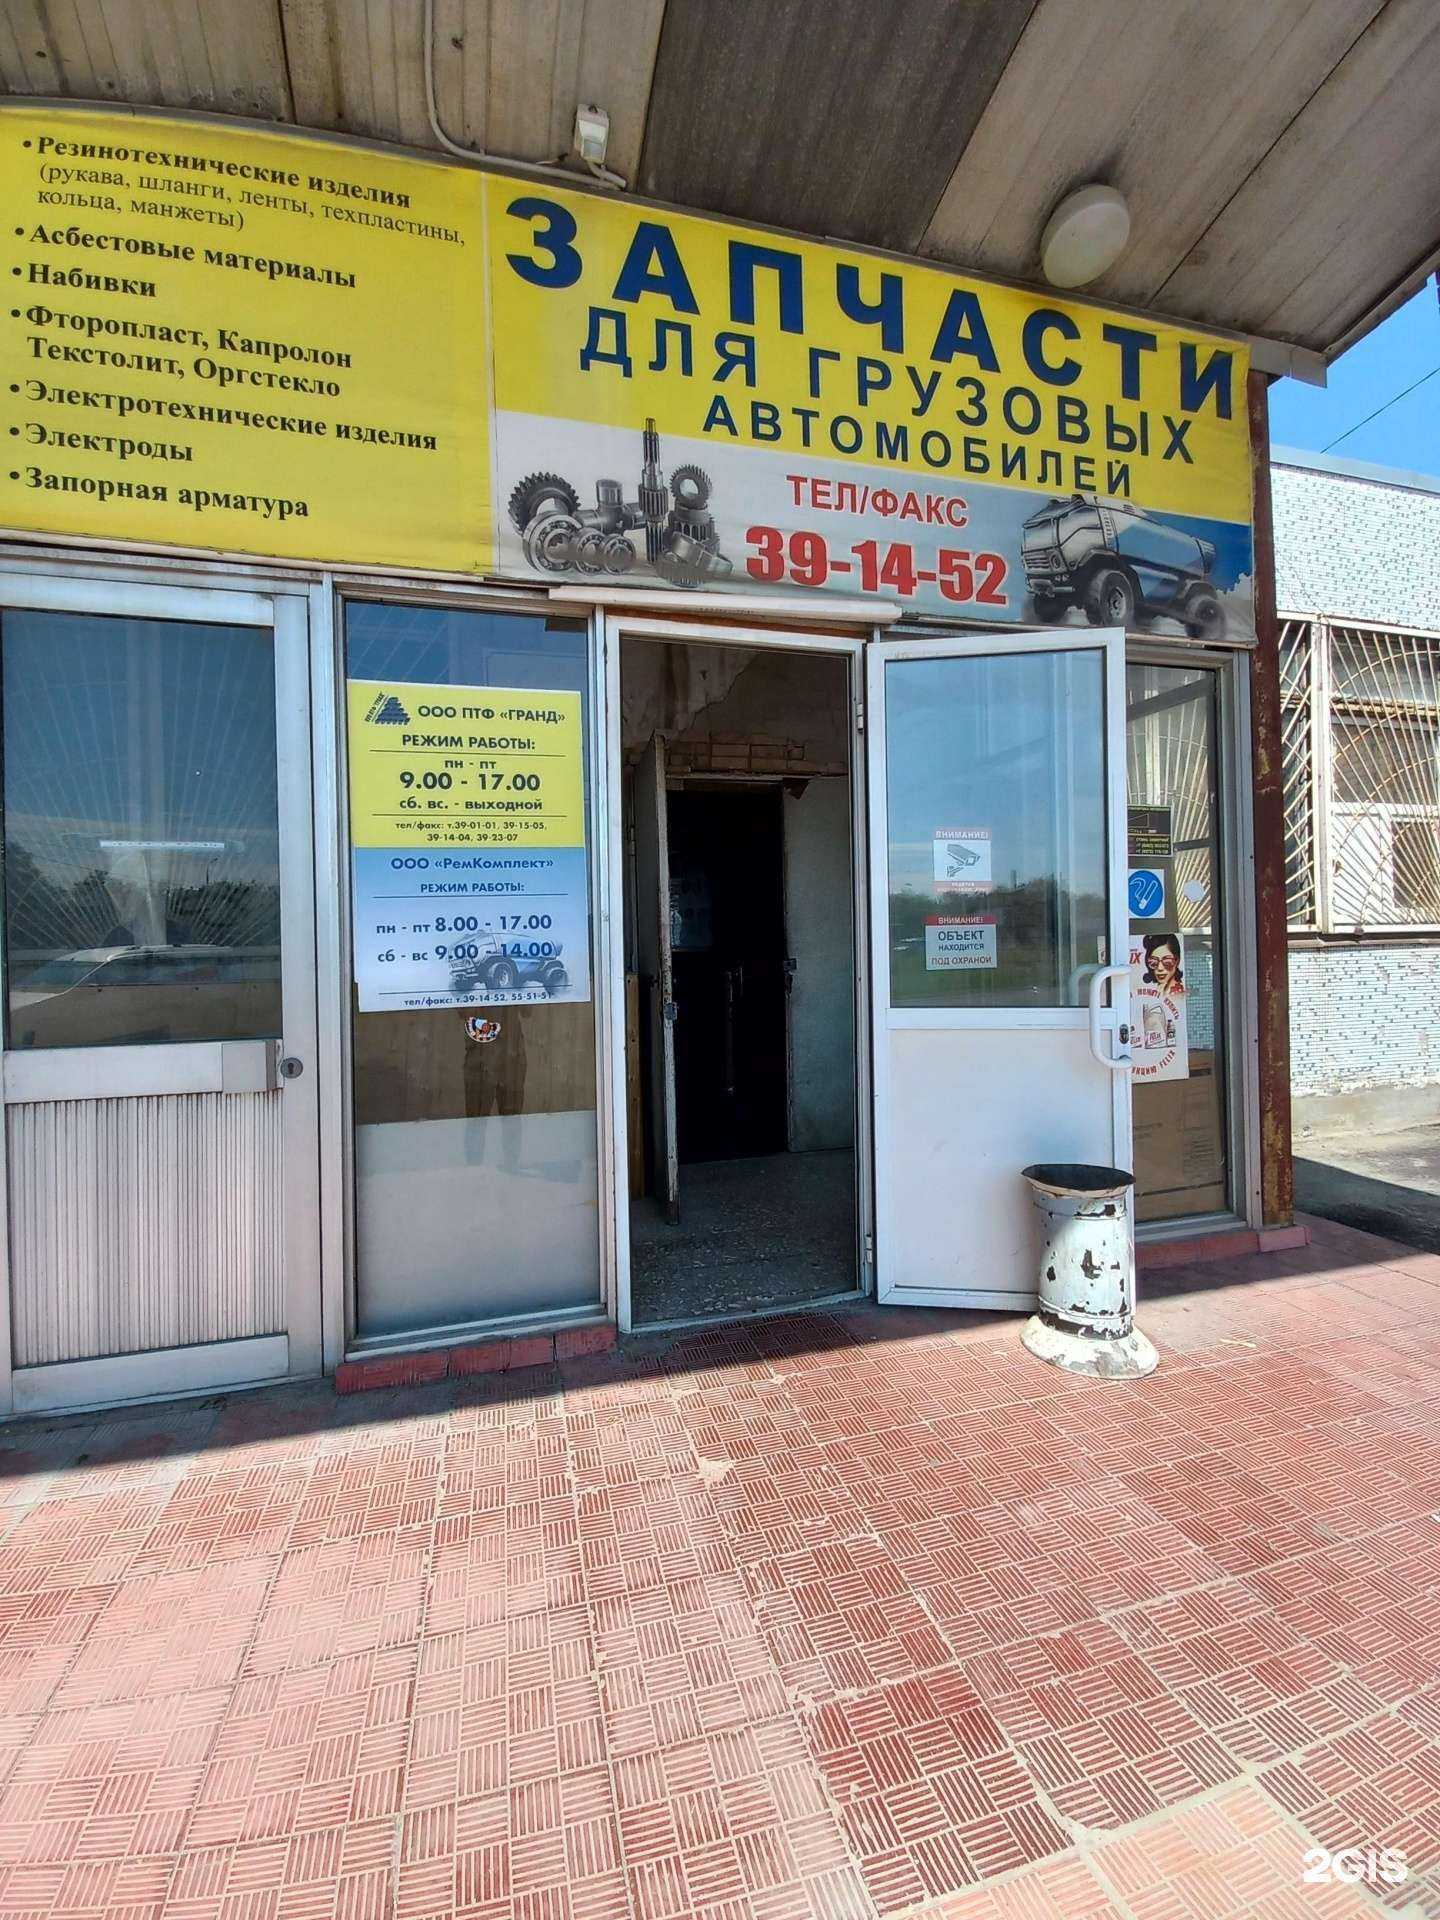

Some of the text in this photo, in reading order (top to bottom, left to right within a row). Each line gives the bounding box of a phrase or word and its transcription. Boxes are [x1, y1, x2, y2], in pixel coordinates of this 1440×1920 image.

[37, 136, 410, 208] Резинотехнические изделия
[37, 190, 244, 231] кольца, манжеты)
[39, 161, 465, 245] (рукава, шланги, ленты, техпластины,
[29, 224, 356, 288] Асбестовые материалы
[27, 264, 156, 297] Набивки
[504, 195, 1234, 420] ЗАПЧАСТИ
[26, 305, 352, 368] Фторопласт, Капролон
[27, 337, 341, 397] Текстолит, Оргстекло
[580, 306, 1194, 465] ДЛЯ ГРУЗОВЫХ
[25, 380, 437, 450] Электротехнические изделия
[25, 423, 193, 461] Электроды
[702, 395, 1131, 498] АВТОМОБИЛЕЙ
[25, 467, 309, 519] Запорная арматура
[786, 474, 968, 528] ТЕЛ/ФАКС
[746, 525, 1008, 605] 39-14-52
[418, 705, 565, 723] ООО ПТФ «ГРАНД»
[402, 734, 535, 750] РЕЖИМ РАБОТЫ:
[445, 760, 464, 769] пн
[480, 761, 496, 769] пт
[400, 772, 452, 789] 9.00
[478, 774, 540, 791] 17.00
[400, 796, 421, 810] сб.
[427, 800, 449, 810] вс.
[465, 798, 543, 811] выходной
[395, 821, 444, 830] тел/факс:
[503, 822, 547, 830] 39-15-05,
[936, 831, 988, 839] ВНИМАНИЕ!
[427, 834, 473, 842] 39-14-04,
[391, 858, 553, 871] ООО «РемКомплект»
[421, 882, 524, 893] РЕЖИМ РАБОТЫ:
[377, 924, 395, 934] пн
[413, 923, 430, 933] пт
[435, 916, 478, 932] 8.00
[499, 915, 551, 930] 17.00
[938, 931, 984, 941] ОБЪЕКТ
[378, 950, 395, 963] сб
[412, 952, 427, 961] вс
[435, 945, 478, 960] 9.00
[500, 943, 552, 958] 14.00
[939, 943, 984, 951] НАХОДИТСЯ
[932, 956, 991, 966] ПОД ОХРАНОЙ
[404, 997, 452, 1007] тел/факс:
